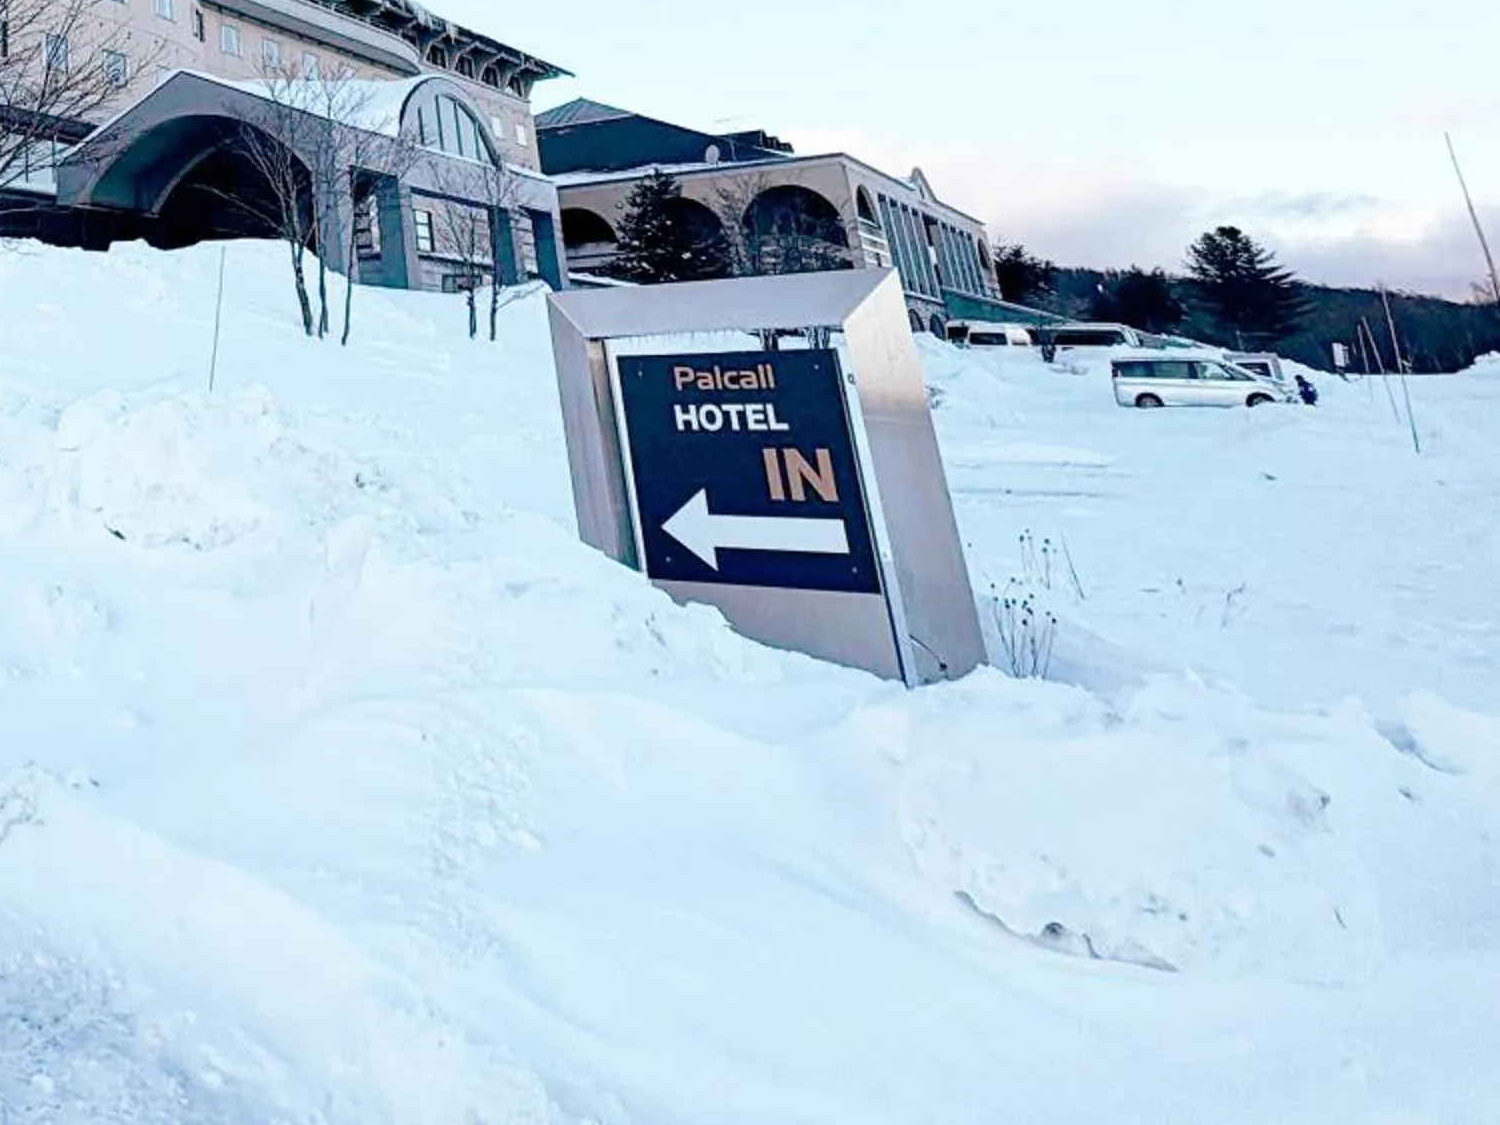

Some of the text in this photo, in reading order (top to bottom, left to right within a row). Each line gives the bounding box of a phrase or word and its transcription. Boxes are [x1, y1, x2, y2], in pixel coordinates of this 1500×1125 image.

[673, 363, 775, 391] Palcall
[673, 403, 790, 432] HOTEL
[762, 447, 839, 502] IN
